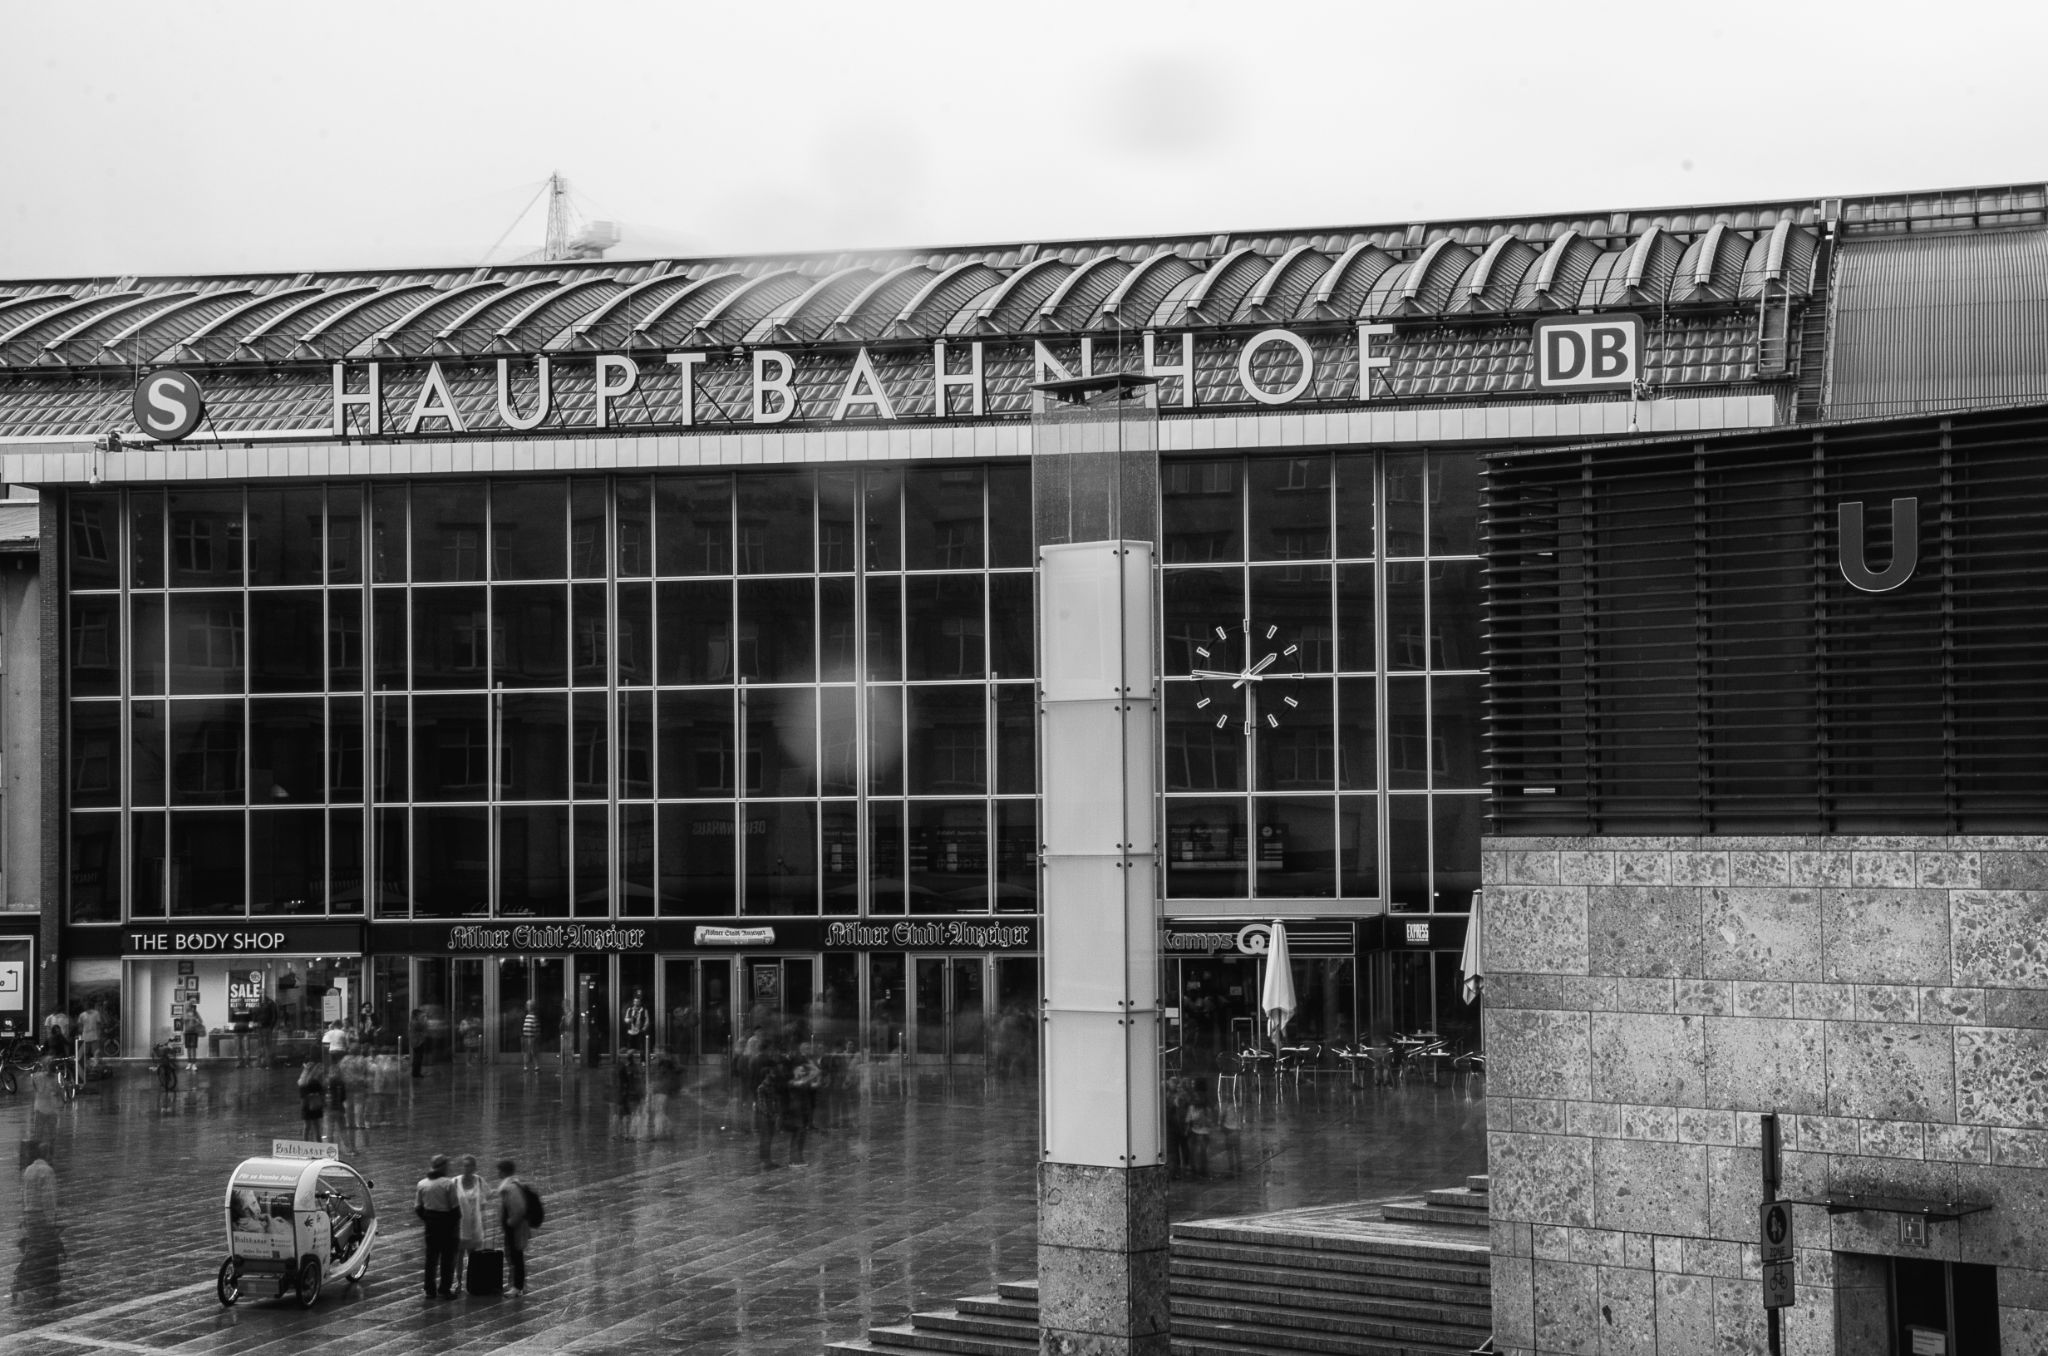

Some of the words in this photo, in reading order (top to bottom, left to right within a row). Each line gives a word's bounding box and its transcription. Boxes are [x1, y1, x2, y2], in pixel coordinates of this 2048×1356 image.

[1547, 327, 1629, 381] DB
[332, 323, 1395, 436] HAUPTBAHNHOF
[147, 377, 187, 432] S
[1838, 497, 1918, 592] U
[131, 934, 168, 950] THE
[175, 933, 229, 950] BODY
[233, 932, 285, 949] SHOP
[448, 926, 511, 950] Kölner
[512, 924, 646, 950] Stadt-Anzeiger
[825, 921, 890, 946] Kölner
[892, 921, 1030, 947] Stadt-Anzeiger
[1161, 929, 1235, 954] Kamps
[1406, 923, 1429, 939] EXPRESS
[230, 983, 260, 998] SALE
[275, 1142, 324, 1156] Balthasar
[1769, 1246, 1786, 1257] ZONE
